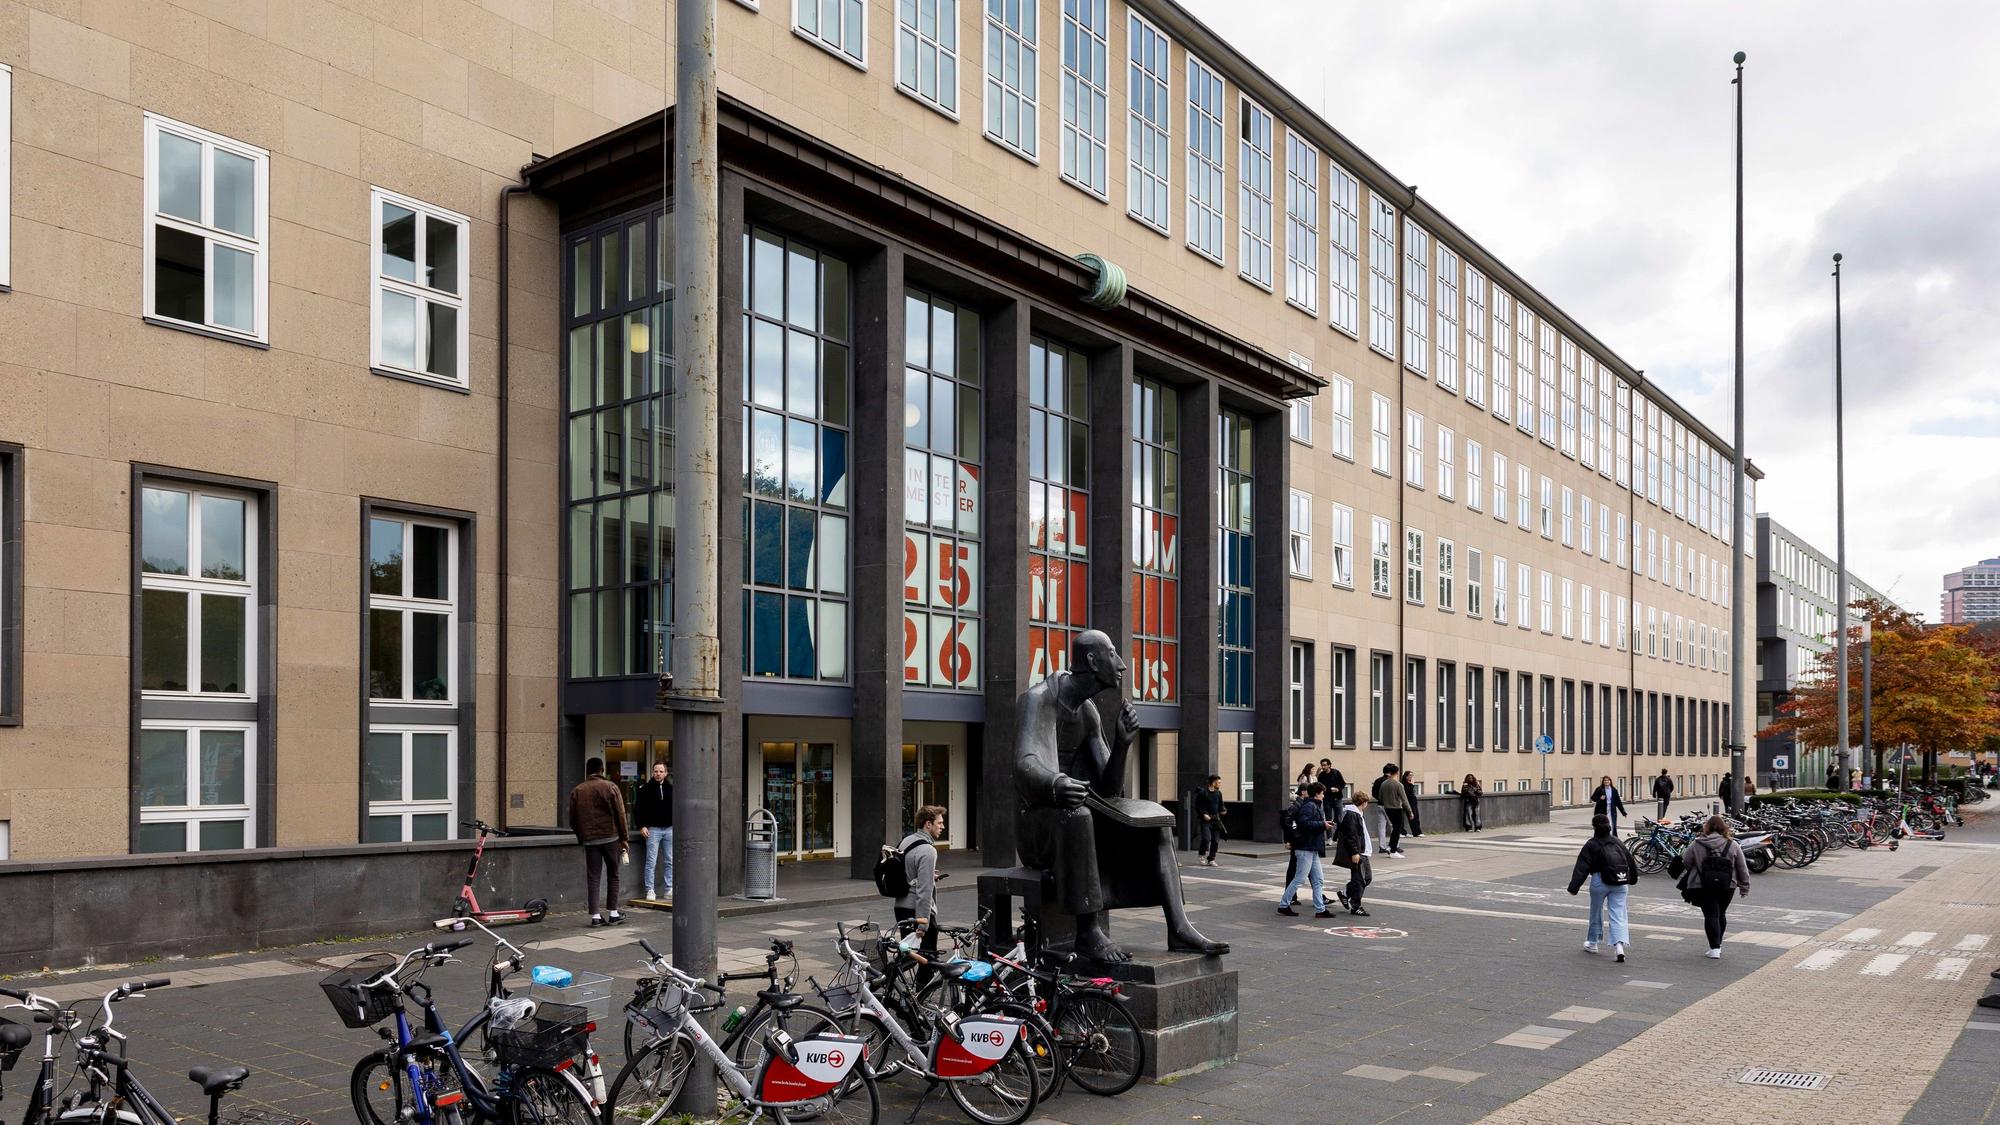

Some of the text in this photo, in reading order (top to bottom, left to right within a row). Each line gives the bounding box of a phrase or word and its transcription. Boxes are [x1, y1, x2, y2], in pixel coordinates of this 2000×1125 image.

[909, 467, 967, 494] INTER
[906, 485, 974, 513] MESTER
[1032, 575, 1057, 622] N
[971, 1033, 989, 1042] KVB
[806, 1053, 827, 1064] KVB
